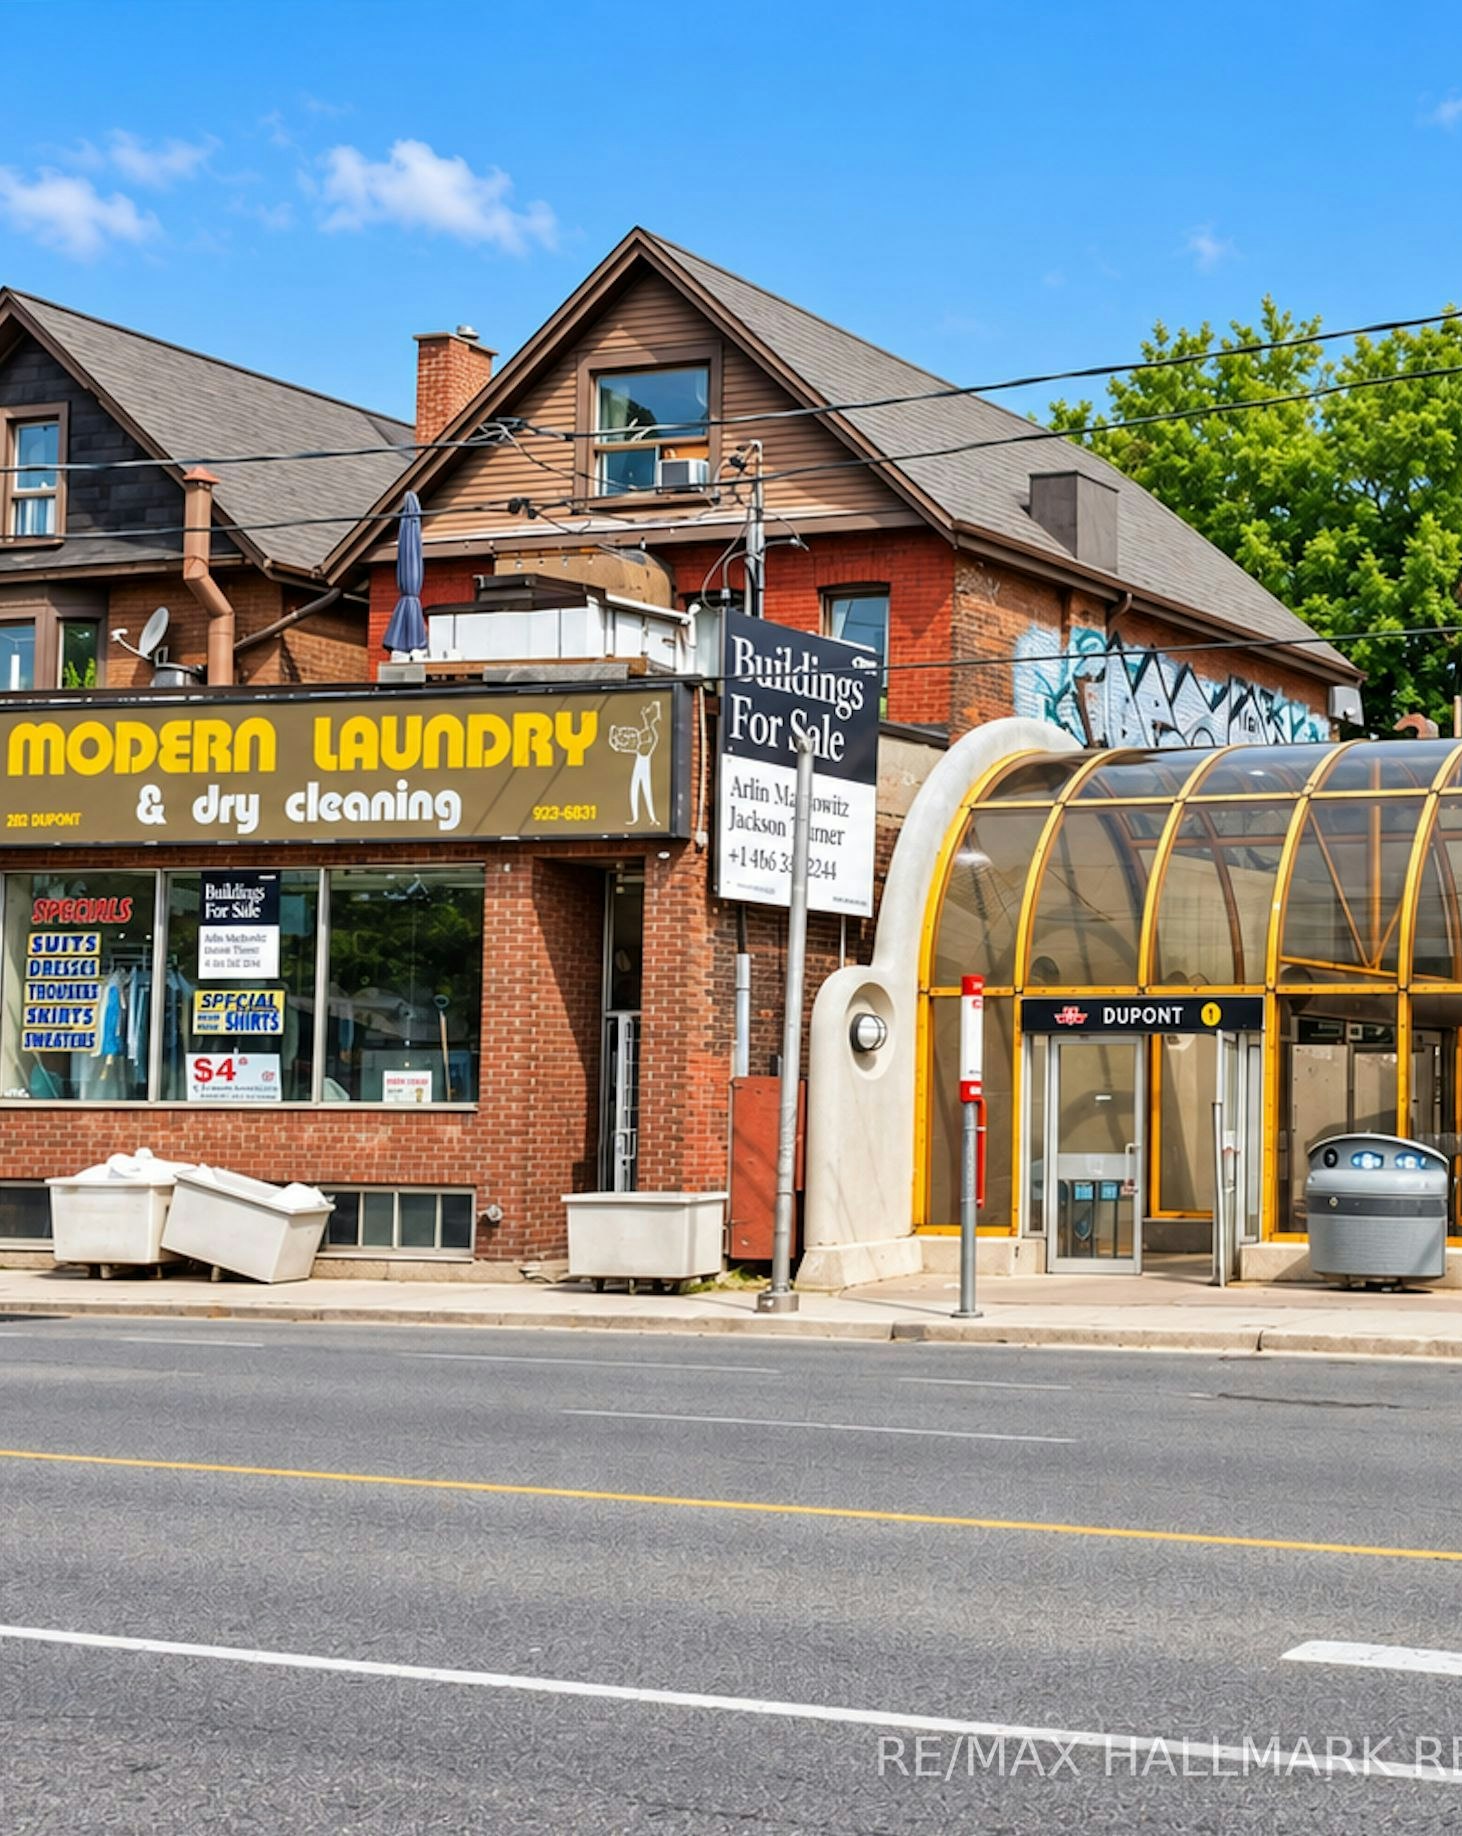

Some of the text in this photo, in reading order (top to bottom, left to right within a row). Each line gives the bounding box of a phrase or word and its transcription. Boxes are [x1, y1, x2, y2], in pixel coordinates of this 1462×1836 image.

[731, 634, 864, 720] Buildings
[7, 710, 598, 777] MODERN LAUNDRY
[729, 693, 845, 762] For Sale
[730, 775, 770, 803] Arlin
[31, 812, 82, 828] DUPONT
[136, 778, 462, 834] & dry cleaning
[728, 805, 786, 838] Jackson
[32, 935, 97, 954] SUITS
[1102, 1006, 1184, 1025] DUPONT
